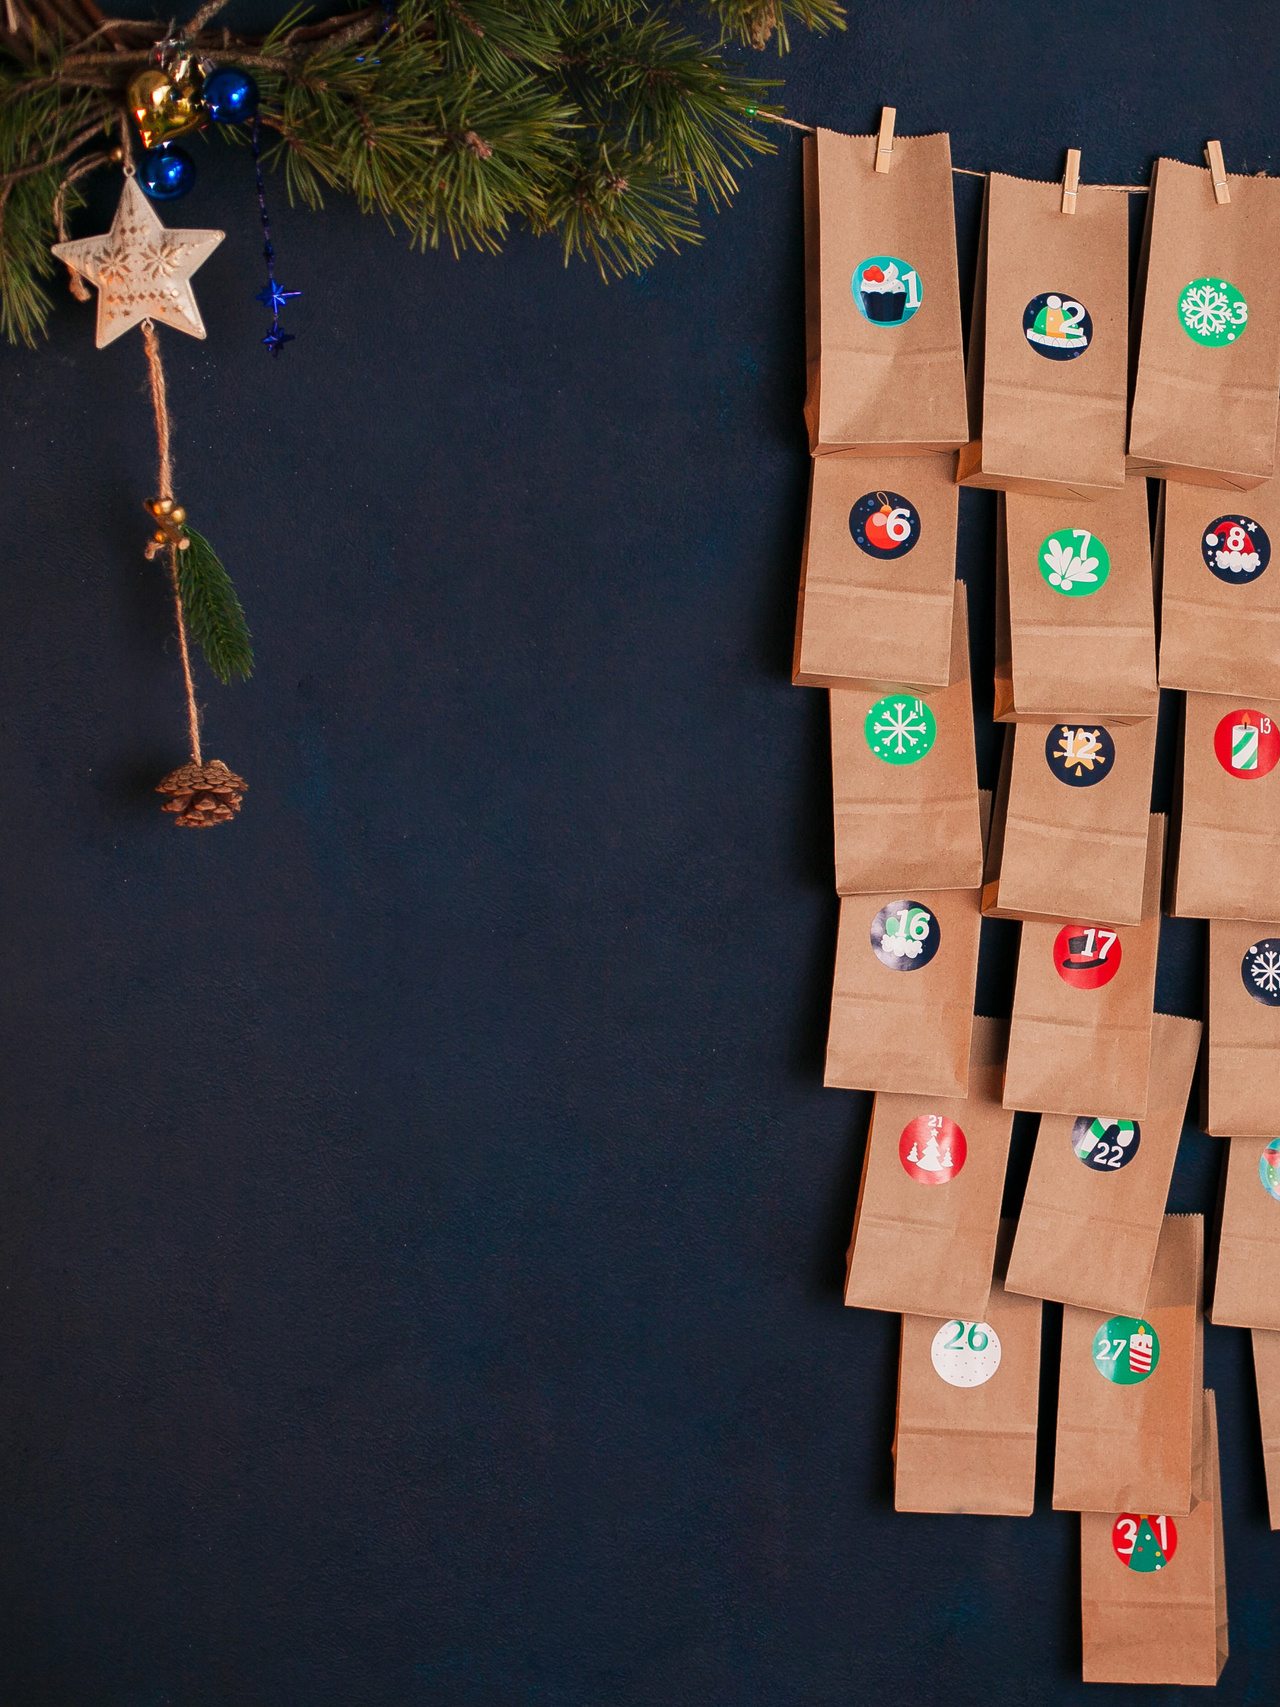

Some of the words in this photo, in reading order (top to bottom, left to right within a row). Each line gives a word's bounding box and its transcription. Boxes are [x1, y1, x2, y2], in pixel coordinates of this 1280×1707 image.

[902, 271, 920, 308] 1
[1059, 301, 1085, 336] 2
[1230, 301, 1248, 324] 3
[886, 508, 911, 541] 6
[1226, 526, 1246, 551] 8
[1072, 530, 1091, 561] 7
[1259, 717, 1271, 735] 13
[1063, 730, 1097, 760] 12
[895, 910, 931, 941] 16
[1080, 928, 1117, 960] 17
[927, 1114, 943, 1128] 21
[1093, 1142, 1124, 1168] 22
[943, 1320, 988, 1352] 26
[1096, 1339, 1127, 1361] 27
[1117, 1515, 1168, 1555] 31
